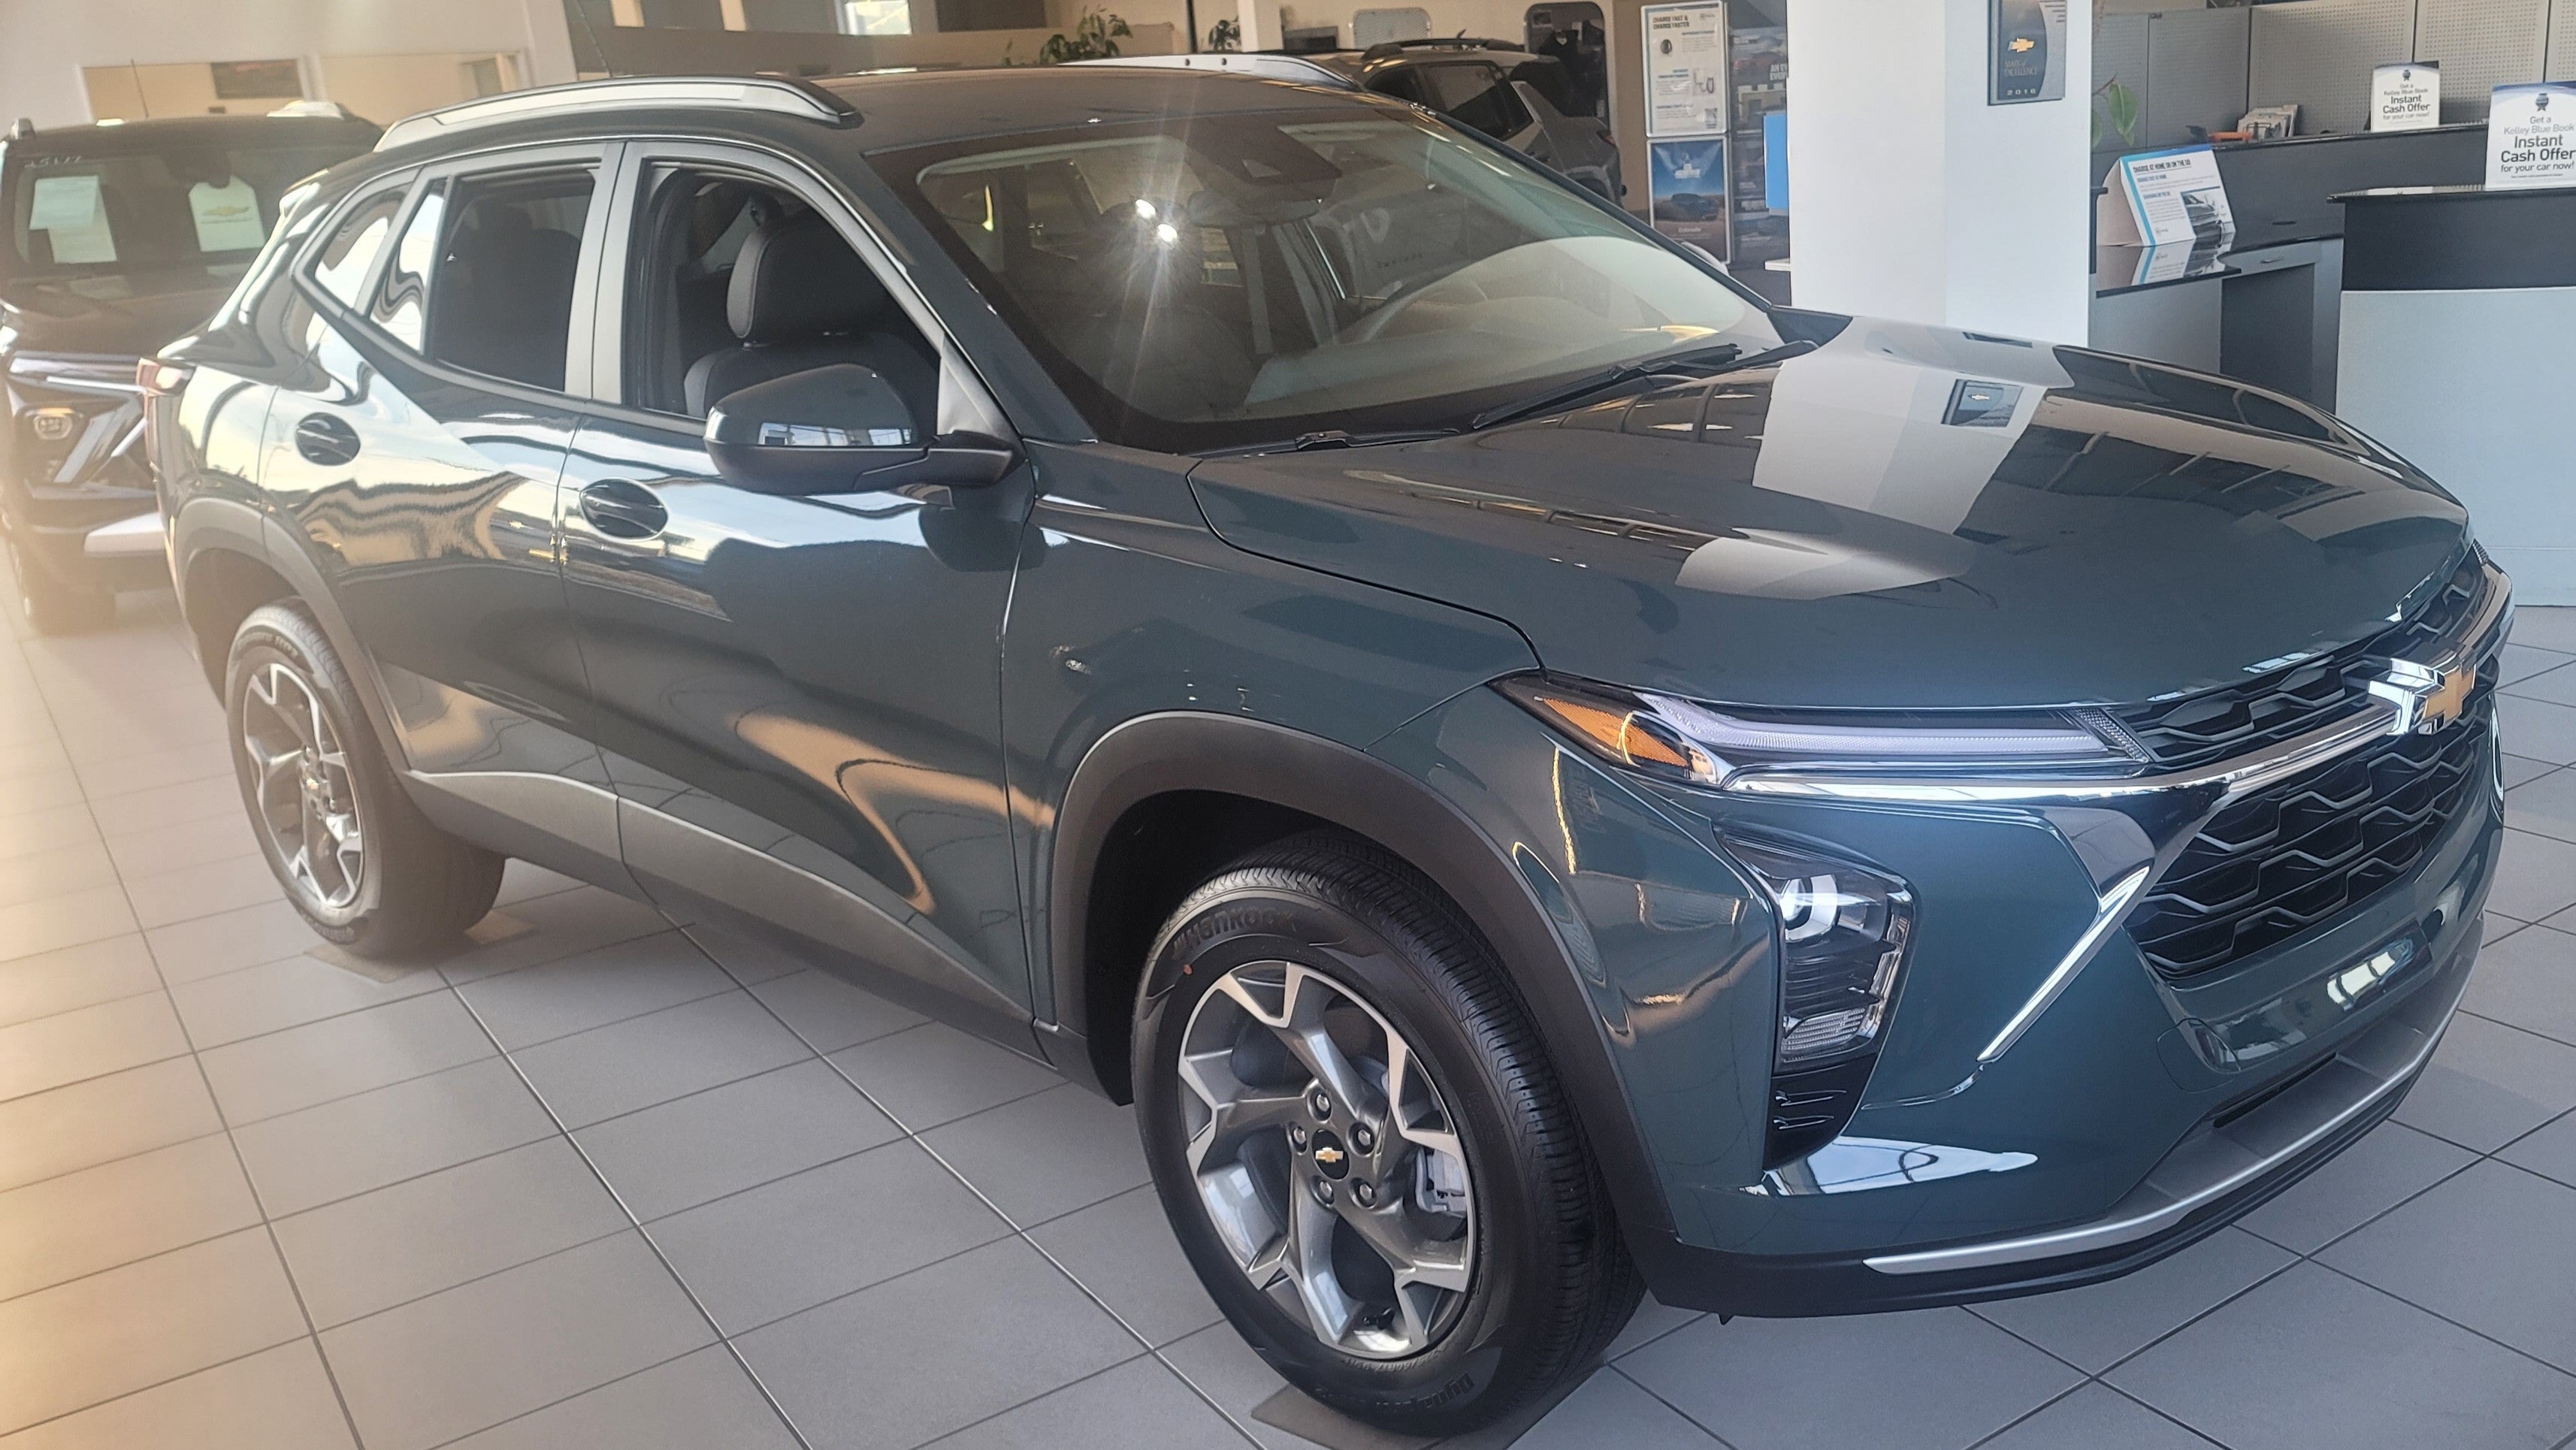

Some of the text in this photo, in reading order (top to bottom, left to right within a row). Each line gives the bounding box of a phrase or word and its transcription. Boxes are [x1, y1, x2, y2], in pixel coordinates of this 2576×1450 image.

[2006, 88, 2036, 96] 2016
[2390, 95, 2422, 104] Instant
[2383, 104, 2430, 113] Cash Offer
[2529, 116, 2544, 124] Get
[2504, 123, 2574, 135] Kelley Blue Book
[2514, 134, 2563, 148] Instant
[2501, 147, 2576, 162] Cash Offer
[2501, 164, 2513, 173] for
[2514, 165, 2535, 174] your
[2553, 161, 2574, 170] now!
